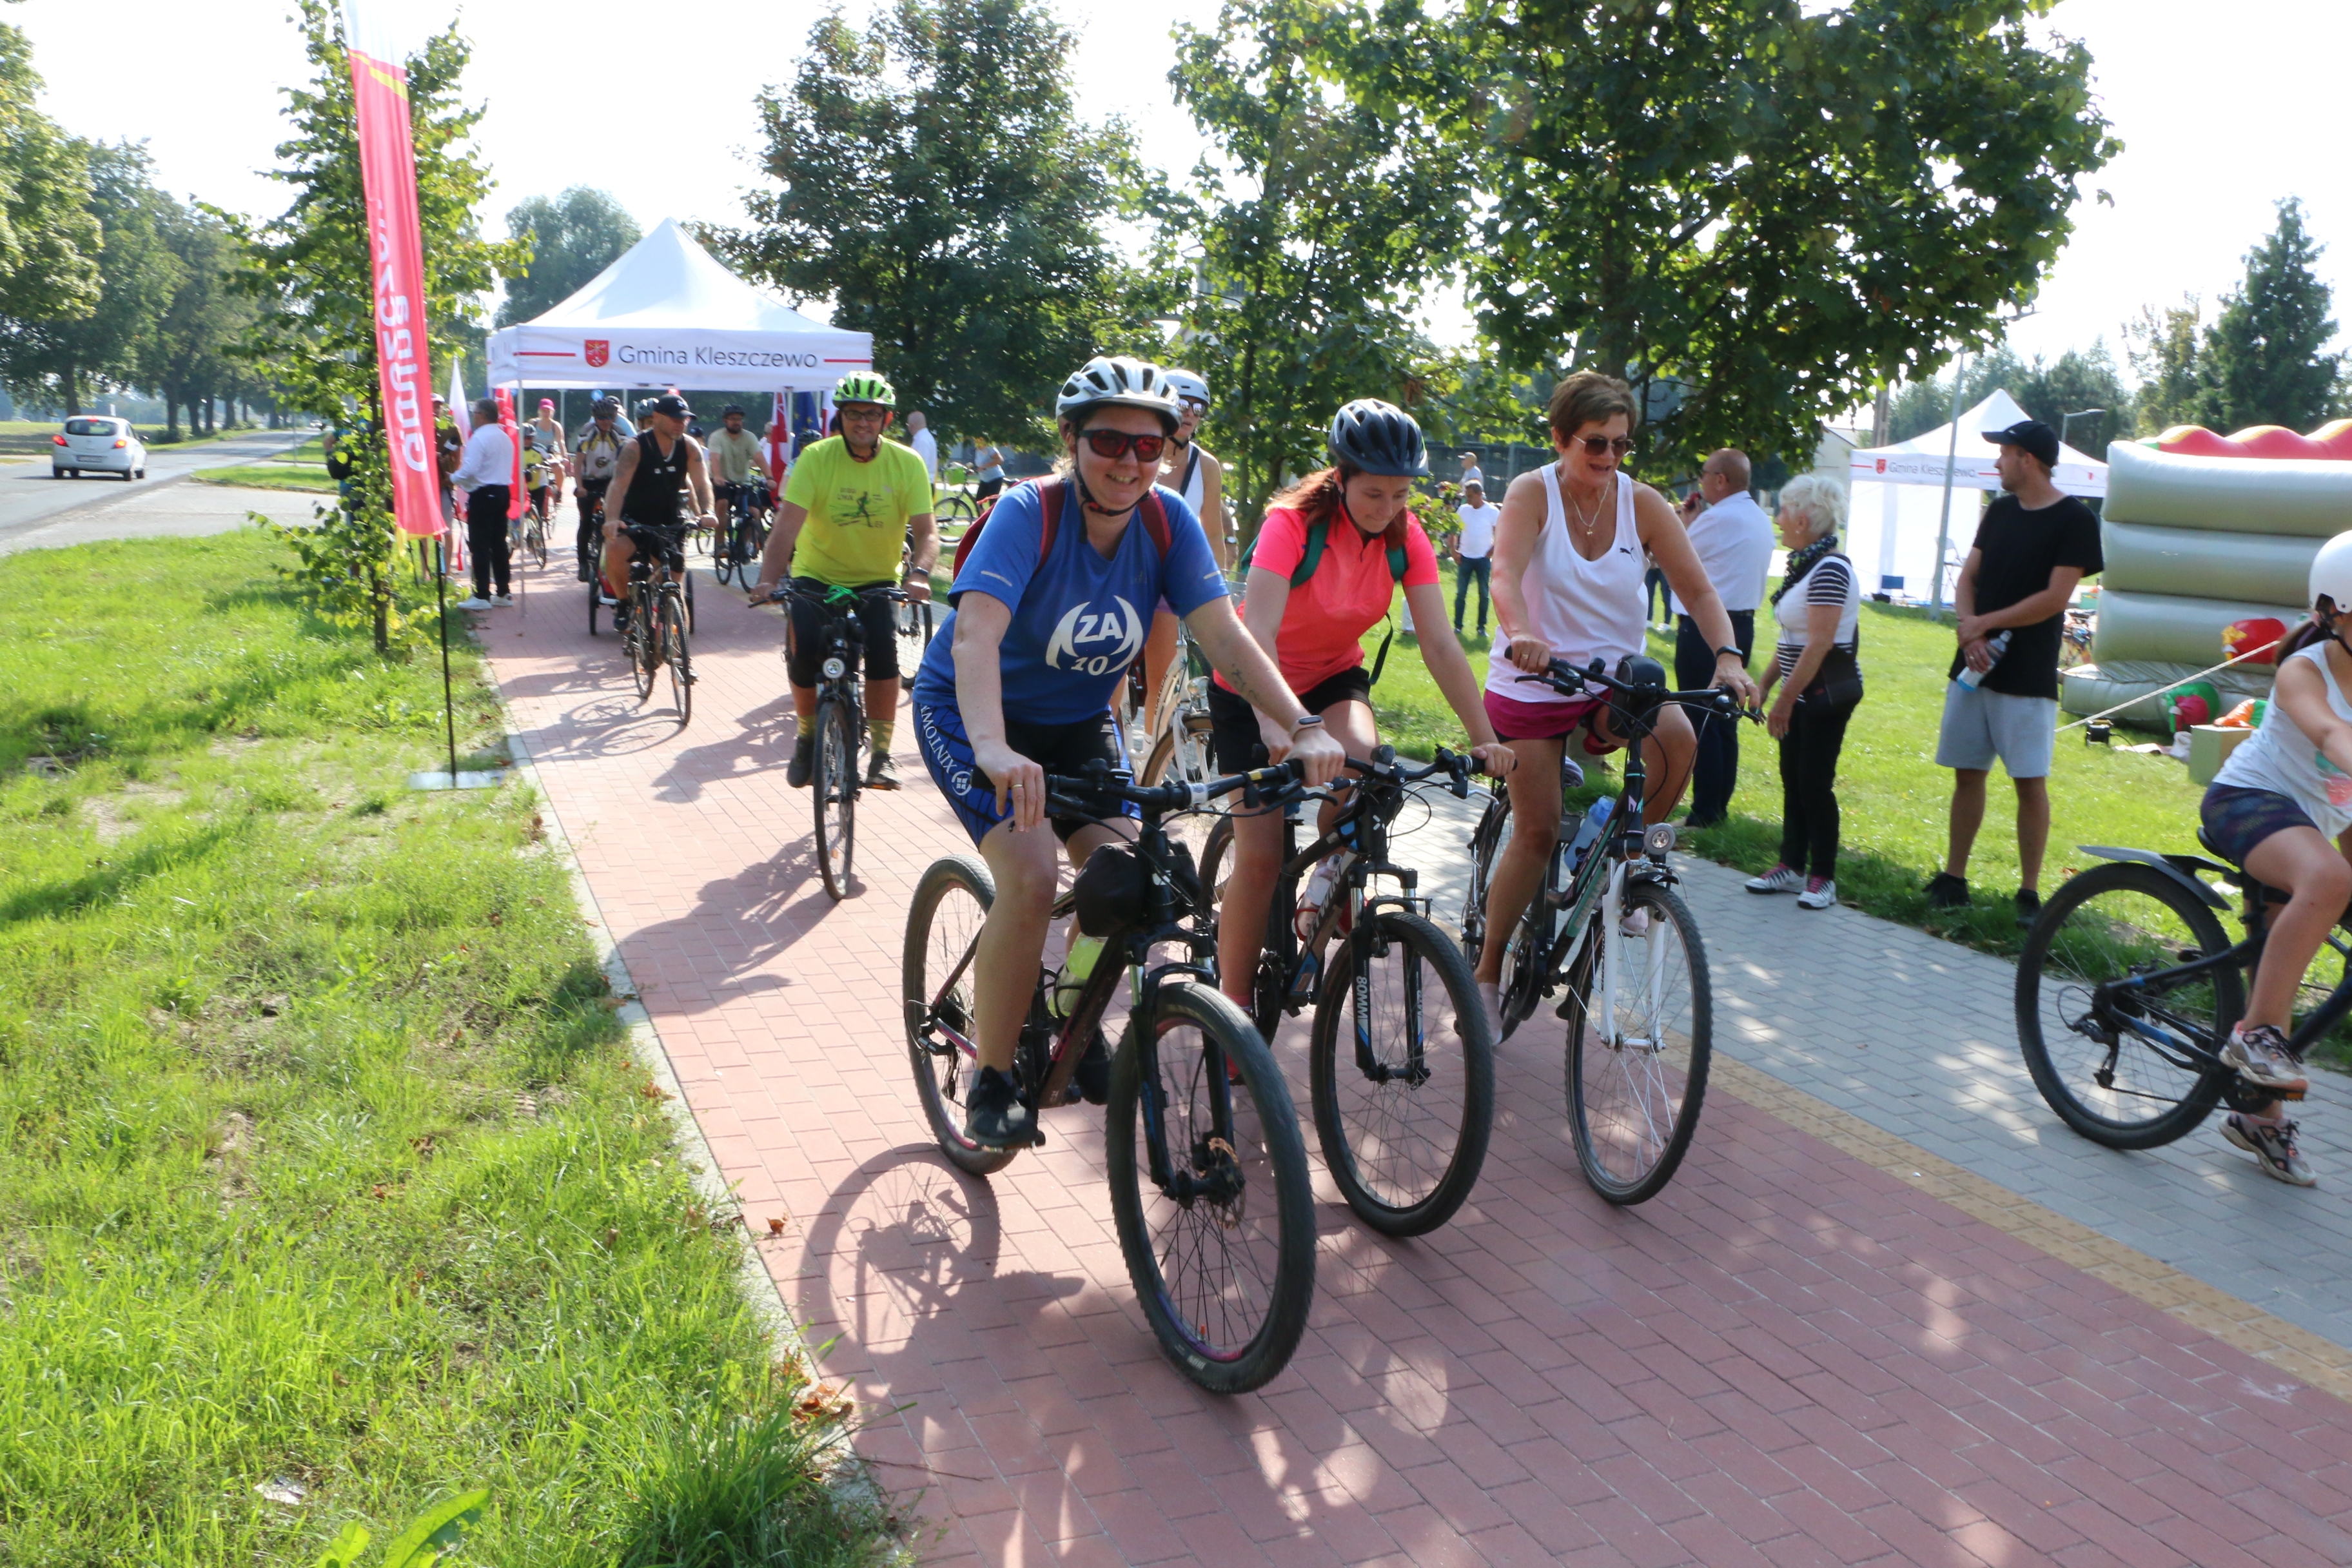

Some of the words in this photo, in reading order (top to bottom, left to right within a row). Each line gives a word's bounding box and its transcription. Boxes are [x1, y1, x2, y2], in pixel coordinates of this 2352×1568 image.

[618, 345, 687, 366] Gmina
[695, 346, 818, 368] Kleszczewo
[1073, 612, 1124, 643] ZA
[1070, 656, 1108, 676] 10
[1356, 975, 1368, 1019] 80MM
